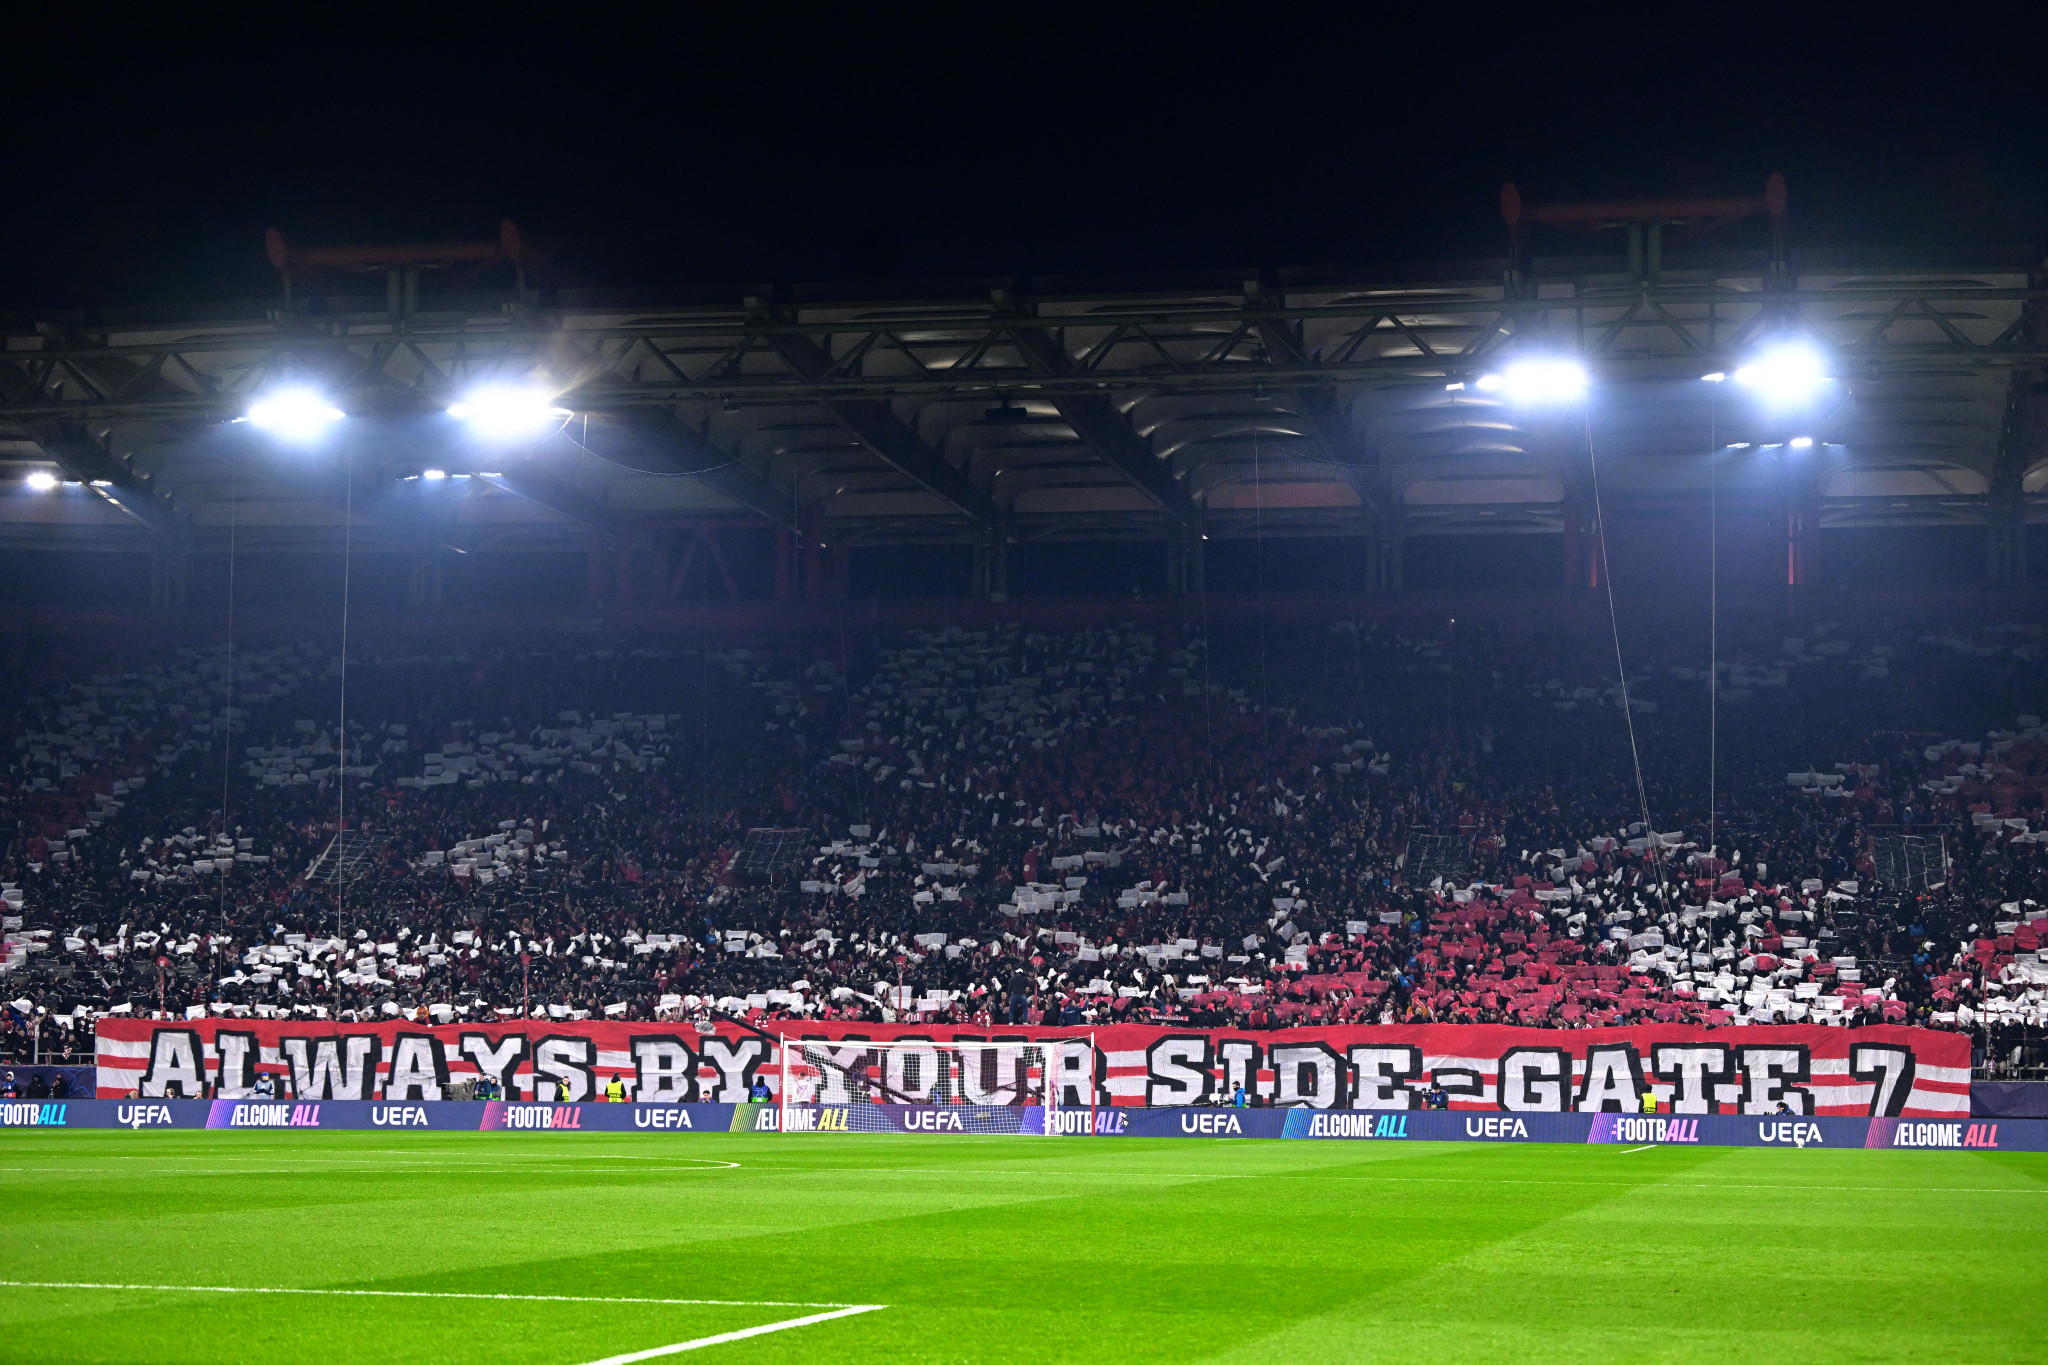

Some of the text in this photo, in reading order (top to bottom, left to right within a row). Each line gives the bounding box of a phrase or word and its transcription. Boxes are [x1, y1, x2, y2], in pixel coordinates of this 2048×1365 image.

[139, 1028, 597, 1102] ALWAYS
[631, 1033, 773, 1102] BY
[801, 1034, 1111, 1106] YOUR
[1146, 1034, 1423, 1109] SIDE
[1498, 1041, 1816, 1116] GATE
[1849, 1042, 1916, 1117] 7
[118, 1105, 172, 1124] UEFA
[230, 1104, 320, 1126] ELCOME ALL
[372, 1106, 428, 1126] UEFA
[635, 1108, 692, 1128] UEFA
[817, 1108, 849, 1131] ALL
[904, 1110, 963, 1130] UEFA
[1181, 1113, 1242, 1134] UEFA
[1308, 1113, 1408, 1137] ELCOME ALL
[1466, 1117, 1528, 1138] UEFA
[1759, 1121, 1823, 1143] UEFA
[1893, 1122, 1999, 1148] ELCOME ALL
